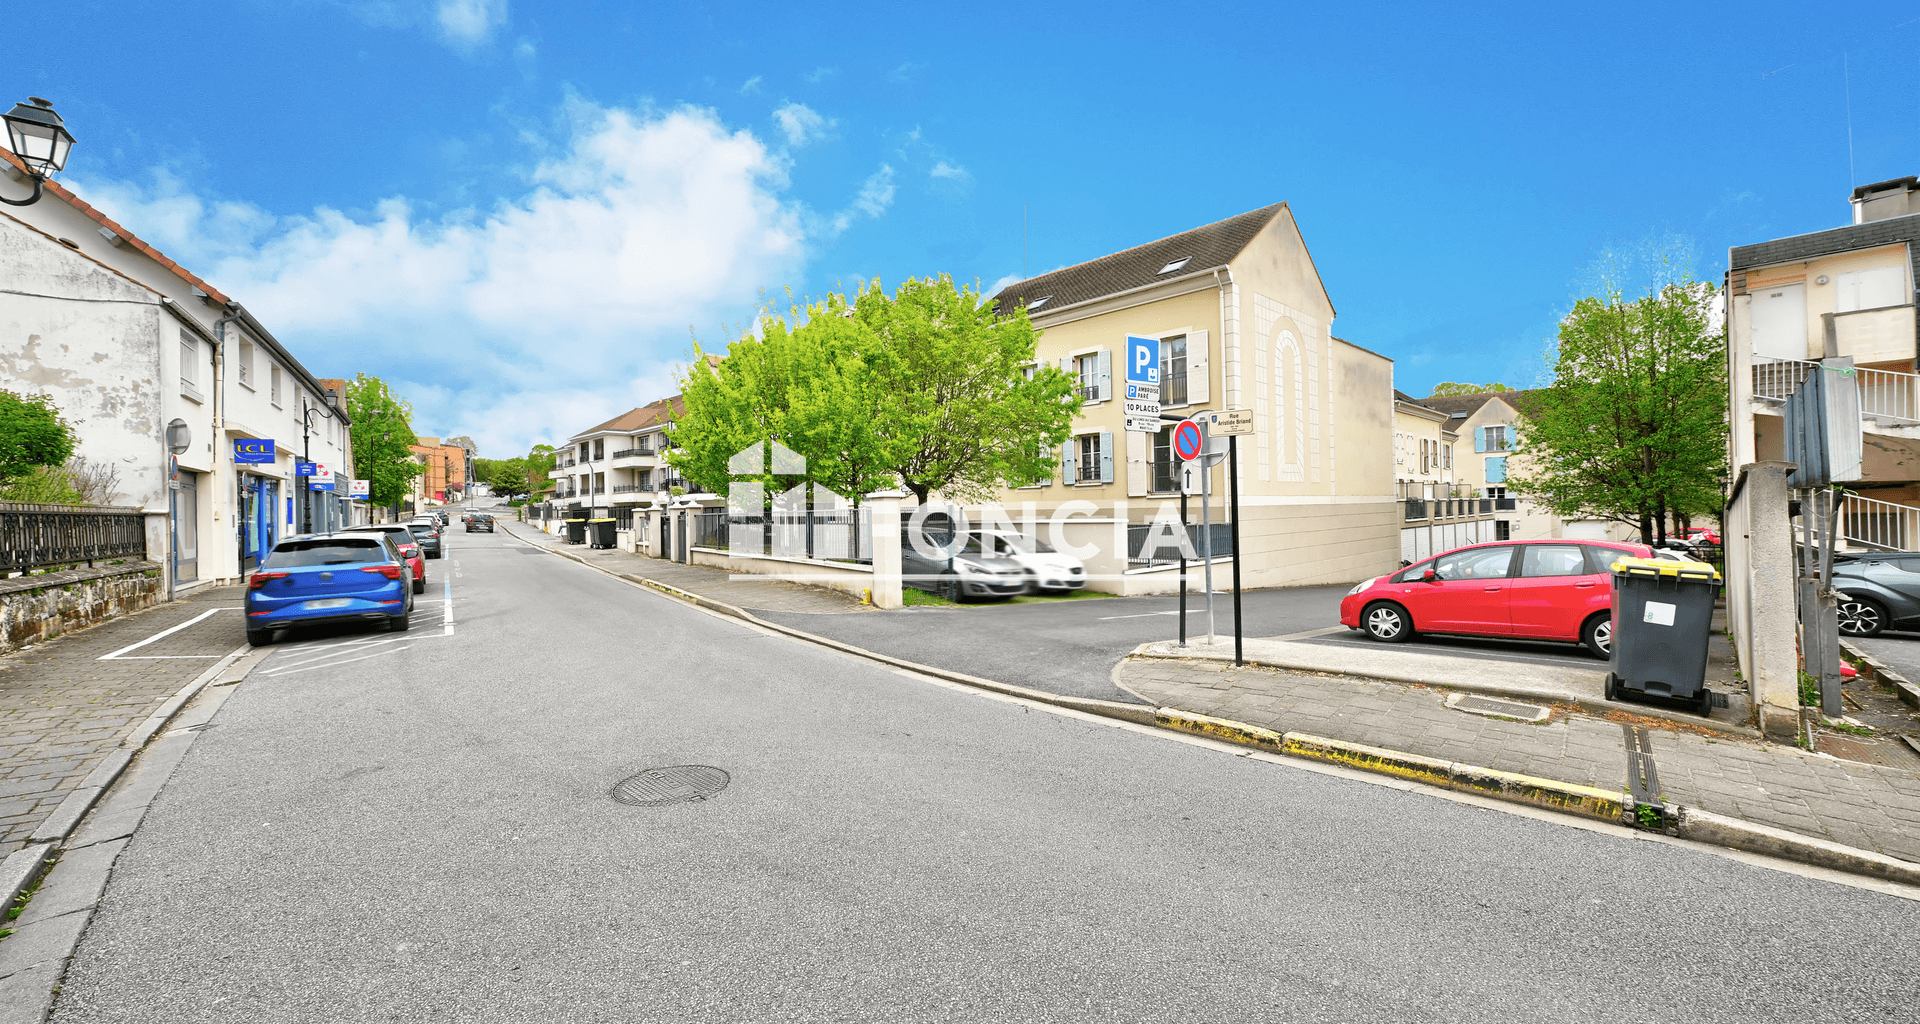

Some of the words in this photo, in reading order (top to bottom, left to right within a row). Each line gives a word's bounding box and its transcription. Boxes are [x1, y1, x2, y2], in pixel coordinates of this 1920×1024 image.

[1136, 345, 1151, 374] P
[1138, 386, 1159, 394] AMBROISE
[1127, 403, 1135, 411] 10
[1135, 404, 1159, 413] PLACES
[237, 444, 270, 453] LCL
